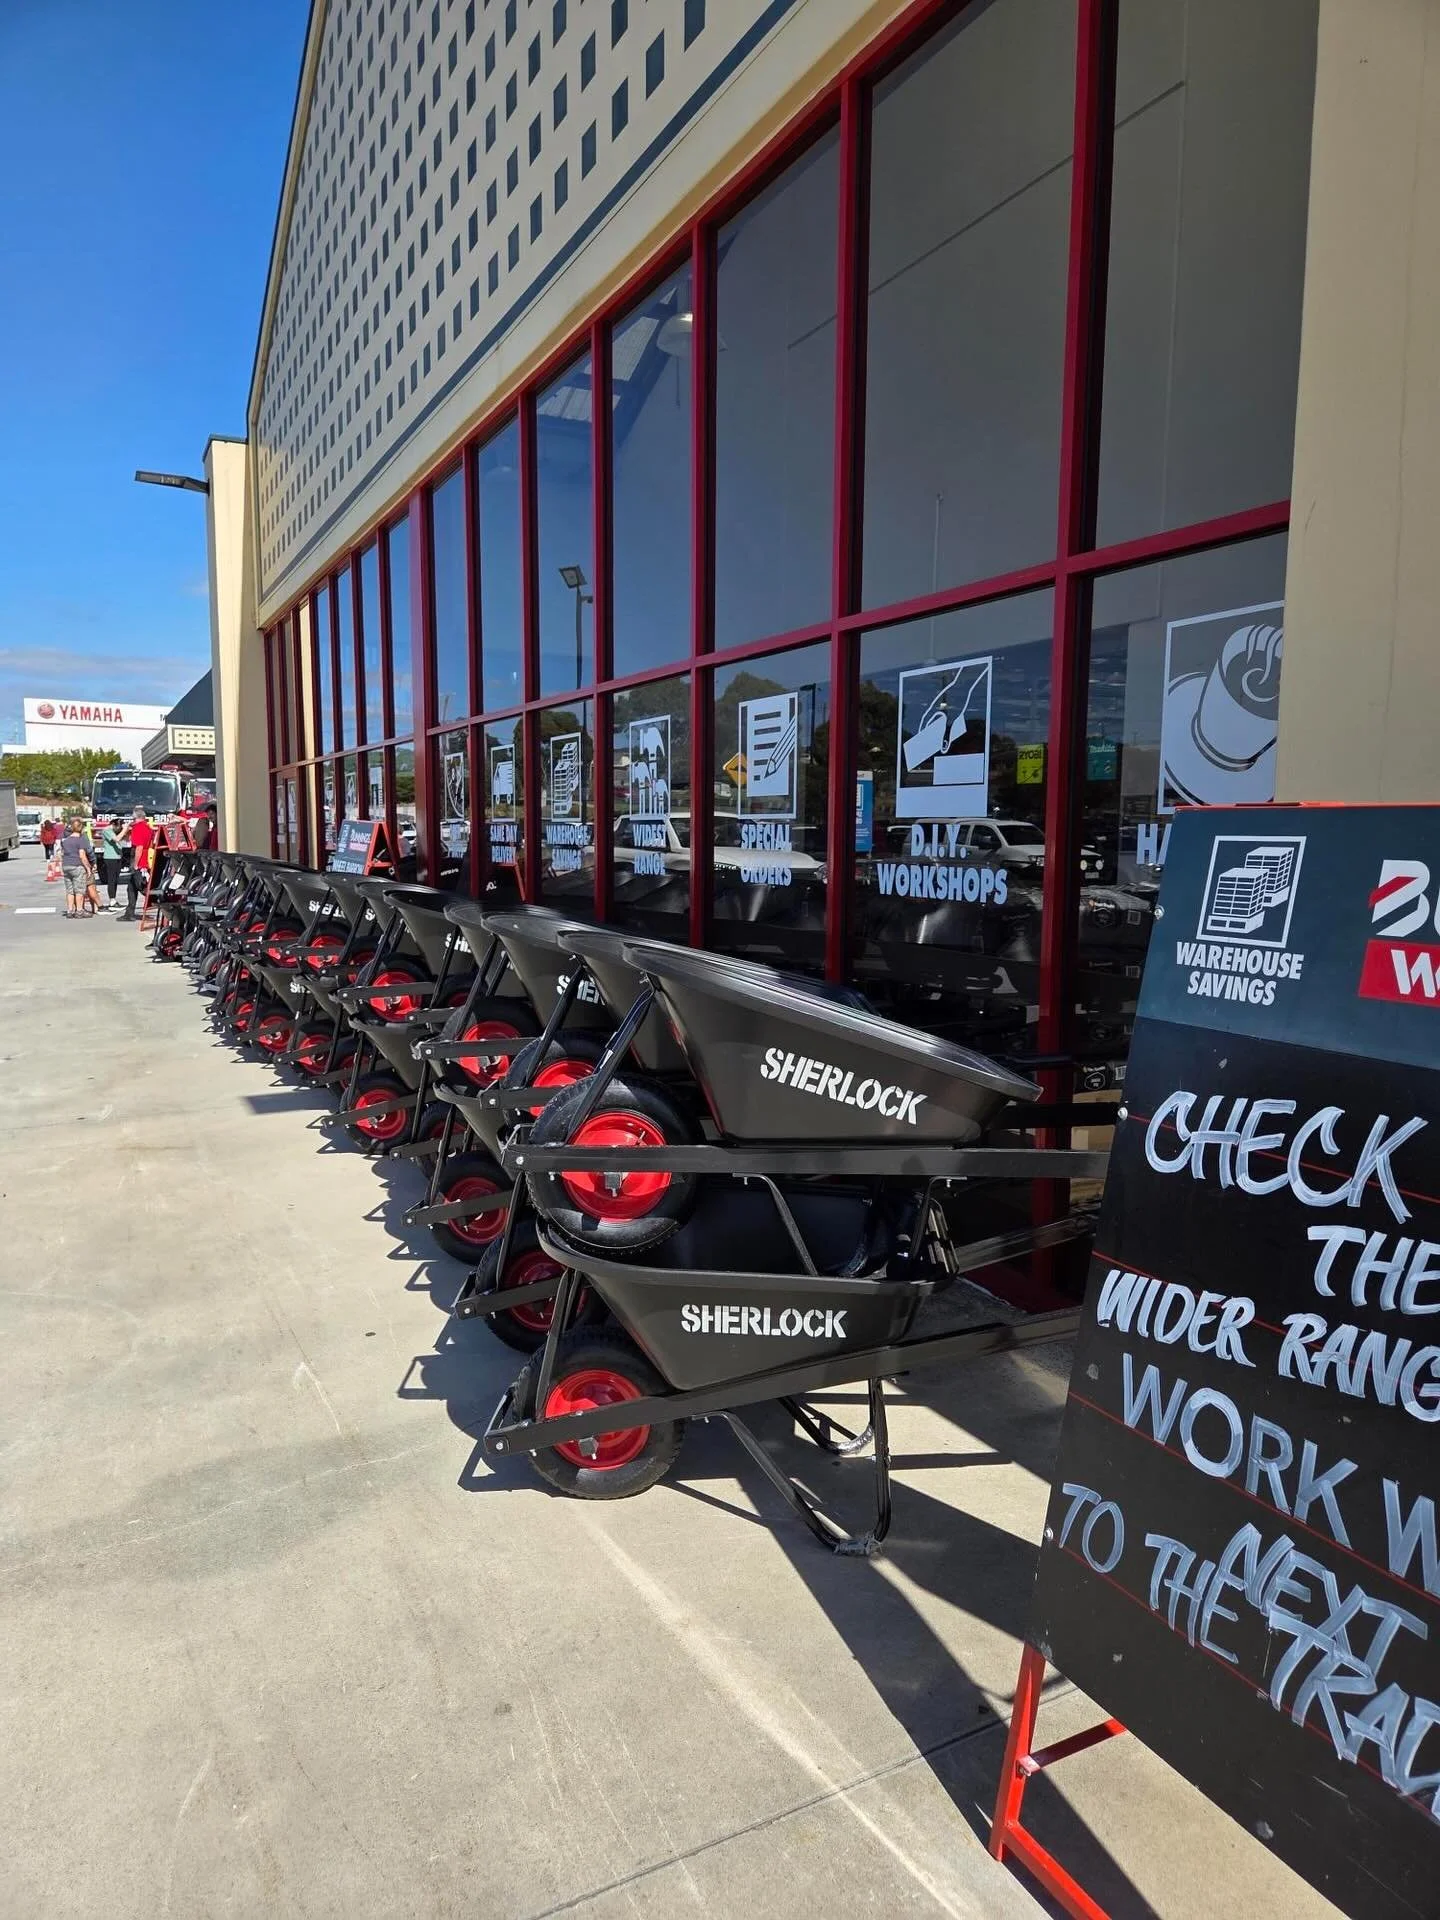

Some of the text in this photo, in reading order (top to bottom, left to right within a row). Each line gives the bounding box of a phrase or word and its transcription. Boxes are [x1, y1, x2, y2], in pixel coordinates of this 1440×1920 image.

[59, 705, 123, 722] YAMAHA
[97, 814, 117, 822] FIRE
[546, 824, 589, 846] WAREHOUSE
[633, 824, 667, 847] WIDEST
[740, 823, 792, 853] SPECIAL
[911, 824, 967, 859] D.I.Y.
[634, 853, 666, 876] RANGE
[740, 859, 792, 886] ORDERS
[876, 863, 1008, 905] WORKSHOPS
[1368, 859, 1440, 938] B
[1176, 941, 1304, 980] WAREHOUSE
[1187, 970, 1277, 1006] SAVINGS
[760, 1047, 928, 1126] SHERLOCK
[1145, 1090, 1429, 1224] CHECK
[1307, 1225, 1440, 1315] THE
[681, 1303, 848, 1338] SHERLOCK
[1097, 1269, 1440, 1423] WIDER RANG
[1122, 1352, 1359, 1551] WORK
[1059, 1482, 1440, 1826] TO THE NEXT TRAD
